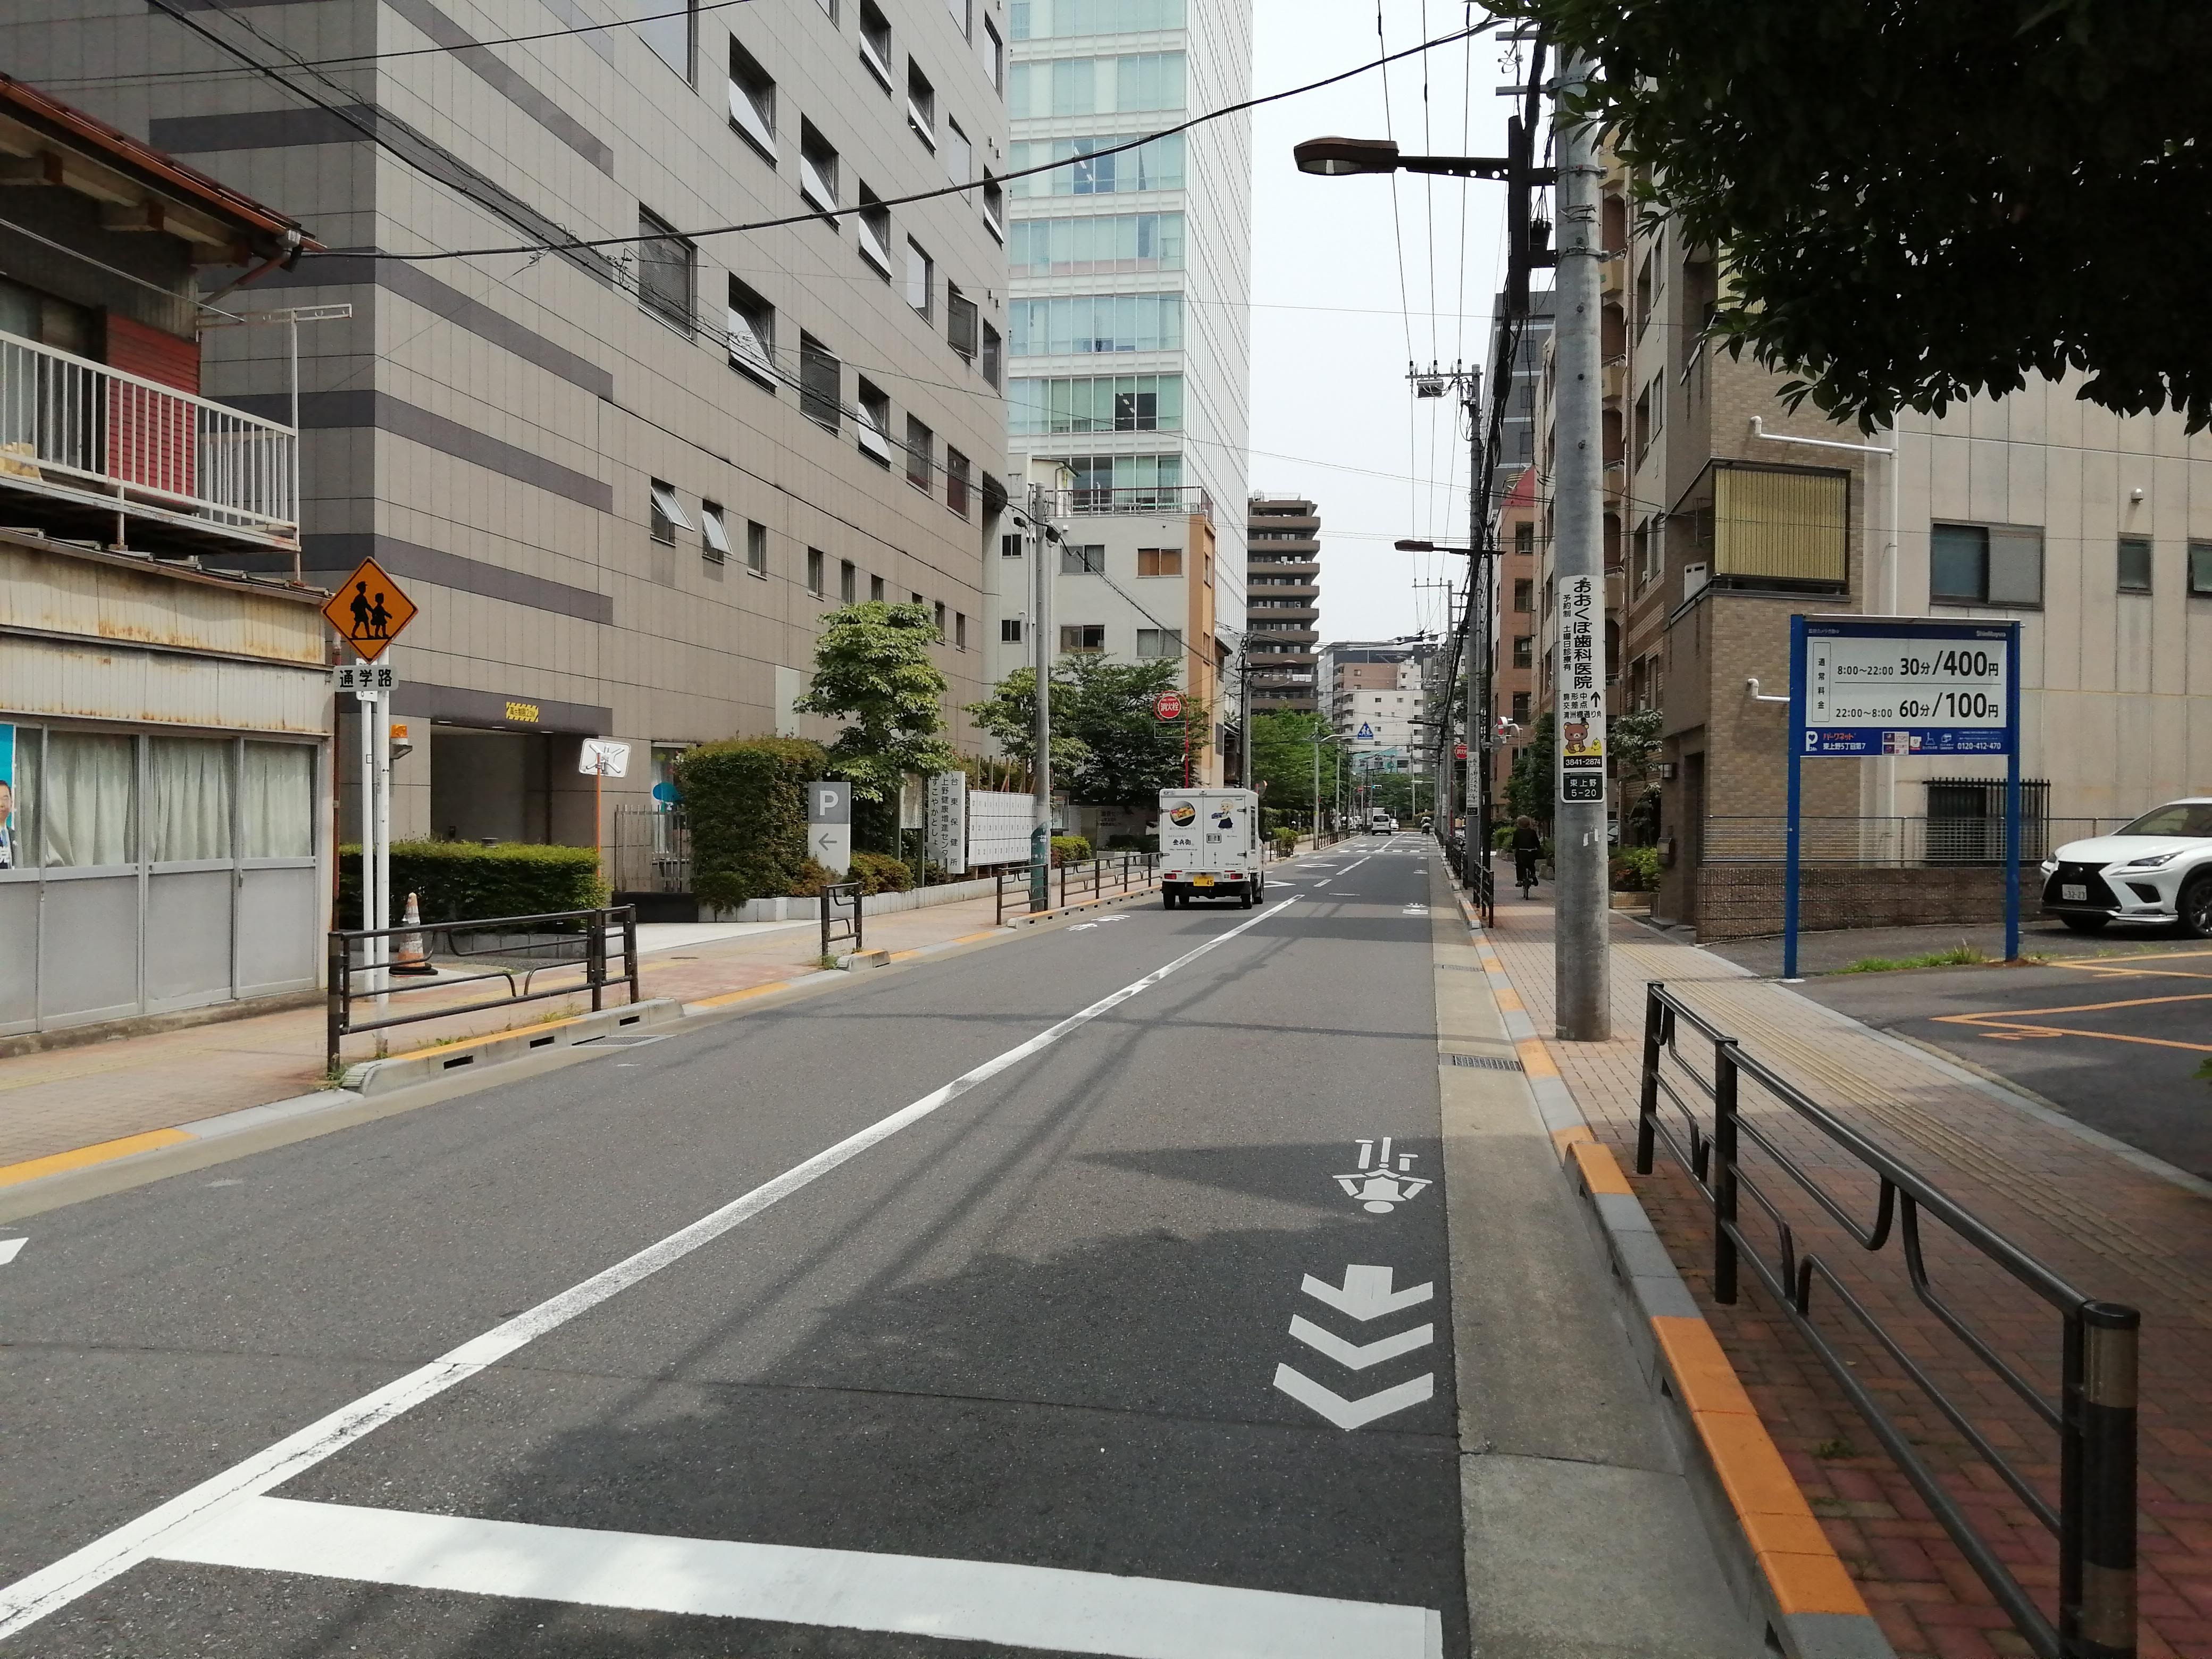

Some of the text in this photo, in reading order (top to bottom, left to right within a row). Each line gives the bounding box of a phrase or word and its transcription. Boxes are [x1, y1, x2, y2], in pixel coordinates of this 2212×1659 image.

[1573, 580, 1592, 689] おおくぼ歯科医院
[340, 669, 392, 688] 通学路
[1160, 702, 1179, 711] 消火栓
[819, 790, 839, 816] P
